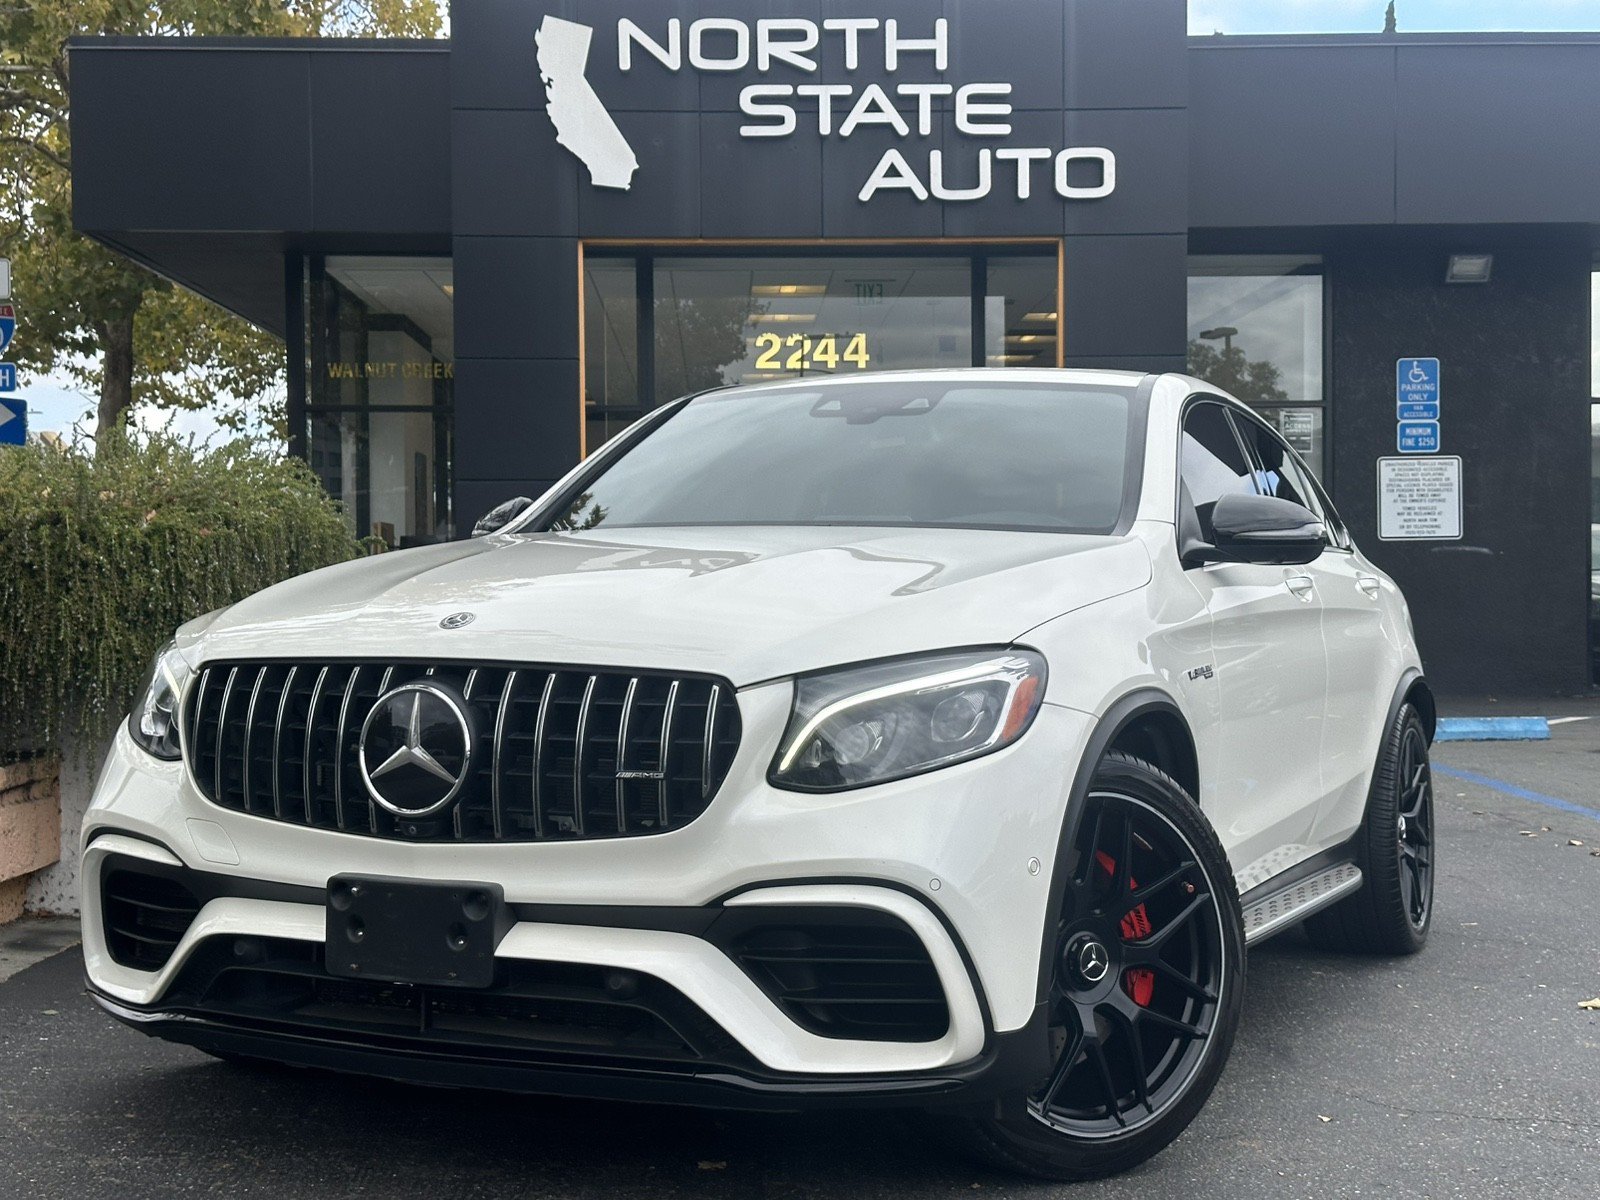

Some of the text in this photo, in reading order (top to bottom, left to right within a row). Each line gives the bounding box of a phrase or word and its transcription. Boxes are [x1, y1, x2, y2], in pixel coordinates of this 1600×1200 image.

[617, 17, 948, 72] NORTH
[738, 82, 1012, 137] STATE
[858, 146, 1116, 202] AUTO
[755, 332, 870, 369] 2244
[327, 362, 454, 379] WALNUT CREEK
[1401, 383, 1436, 392] PARKING
[1408, 393, 1428, 401] ONLY
